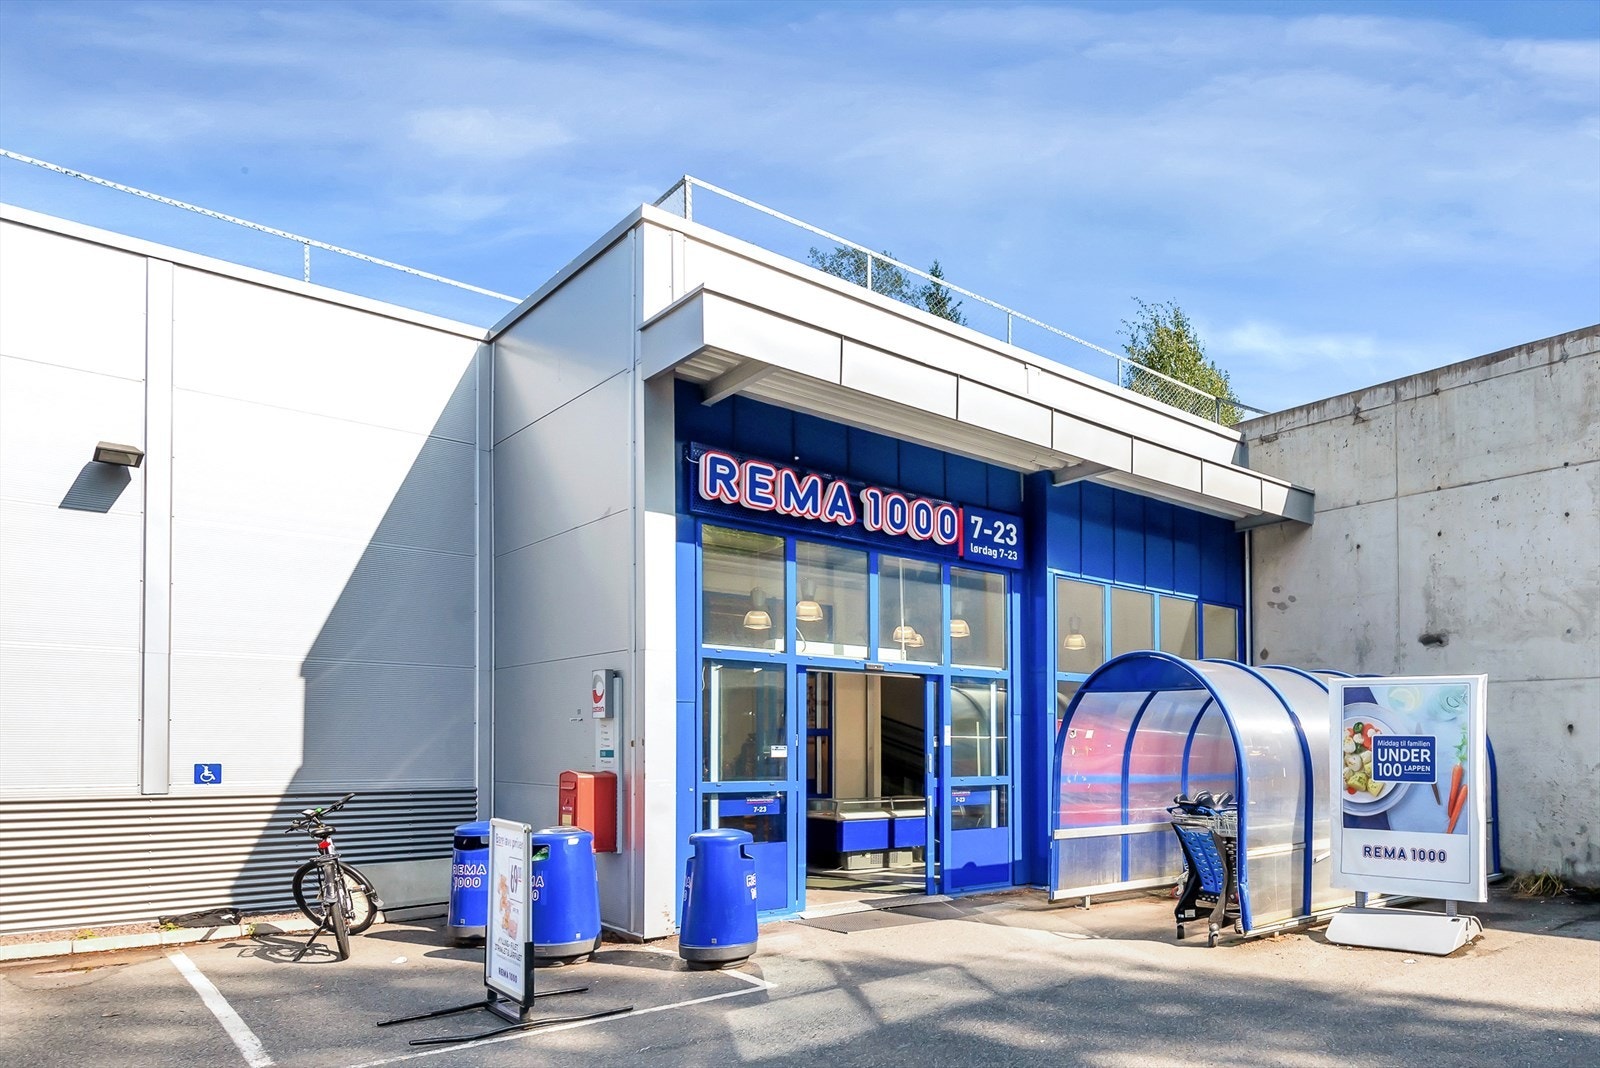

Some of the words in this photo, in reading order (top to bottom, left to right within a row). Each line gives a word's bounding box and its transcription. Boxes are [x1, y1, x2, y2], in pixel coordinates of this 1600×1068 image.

[700, 451, 856, 526] REMA
[861, 487, 959, 545] 1000
[970, 515, 1018, 546] 7-23
[970, 543, 998, 559] lørdag
[999, 548, 1018, 561] 7-23
[1377, 740, 1400, 748] Middag
[1377, 748, 1431, 763] UNDER
[1377, 763, 1402, 777] 100
[1363, 844, 1408, 861] REMA
[1410, 847, 1448, 863] 1000
[453, 864, 487, 876] REMA
[453, 876, 482, 889] 1000
